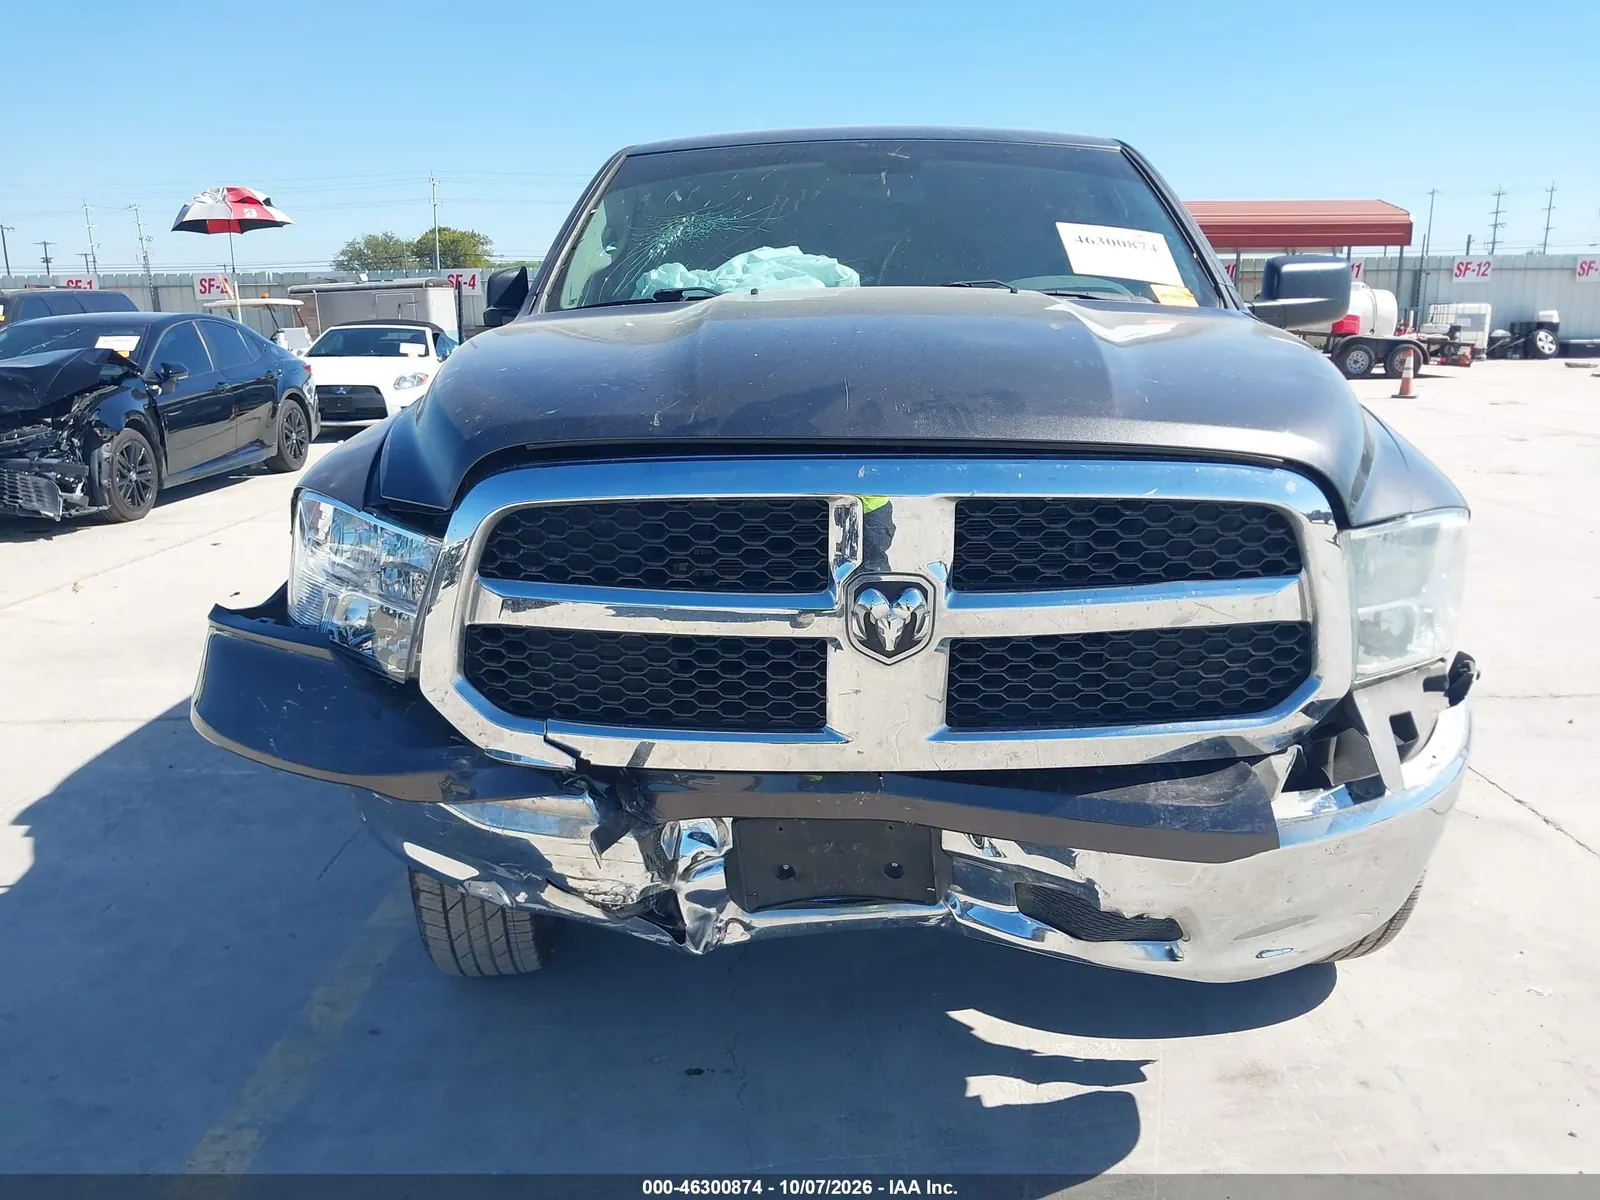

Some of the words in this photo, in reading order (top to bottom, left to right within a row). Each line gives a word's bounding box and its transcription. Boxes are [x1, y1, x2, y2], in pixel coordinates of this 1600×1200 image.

[1073, 235, 1157, 252] 46300874
[1454, 261, 1491, 278] SF-12
[1578, 260, 1600, 276] SF-
[447, 274, 476, 290] SF-4
